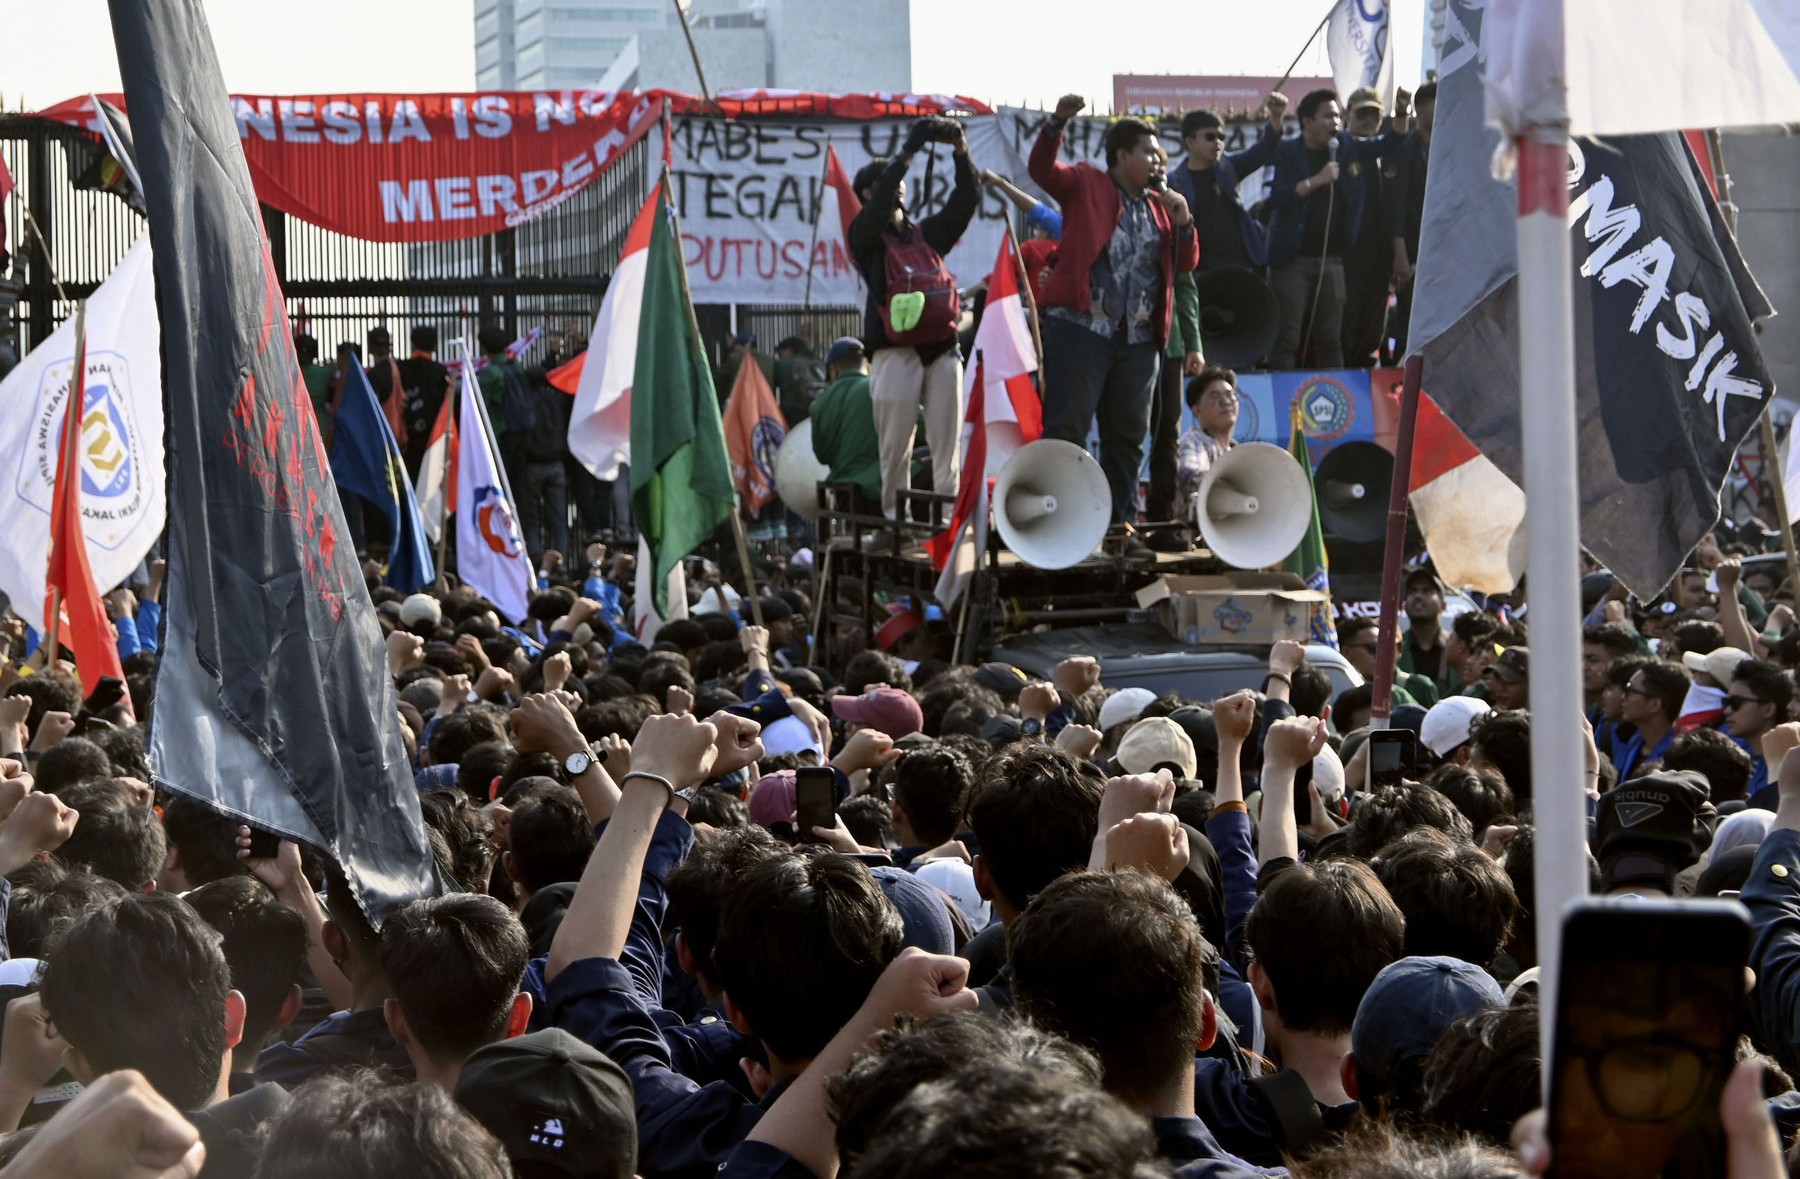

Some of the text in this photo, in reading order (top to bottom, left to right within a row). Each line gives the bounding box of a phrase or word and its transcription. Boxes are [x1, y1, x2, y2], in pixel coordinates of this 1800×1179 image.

[231, 88, 622, 144] NESIA IS NO
[1313, 404, 1333, 417] SPSI
[530, 1133, 564, 1147] MLB
